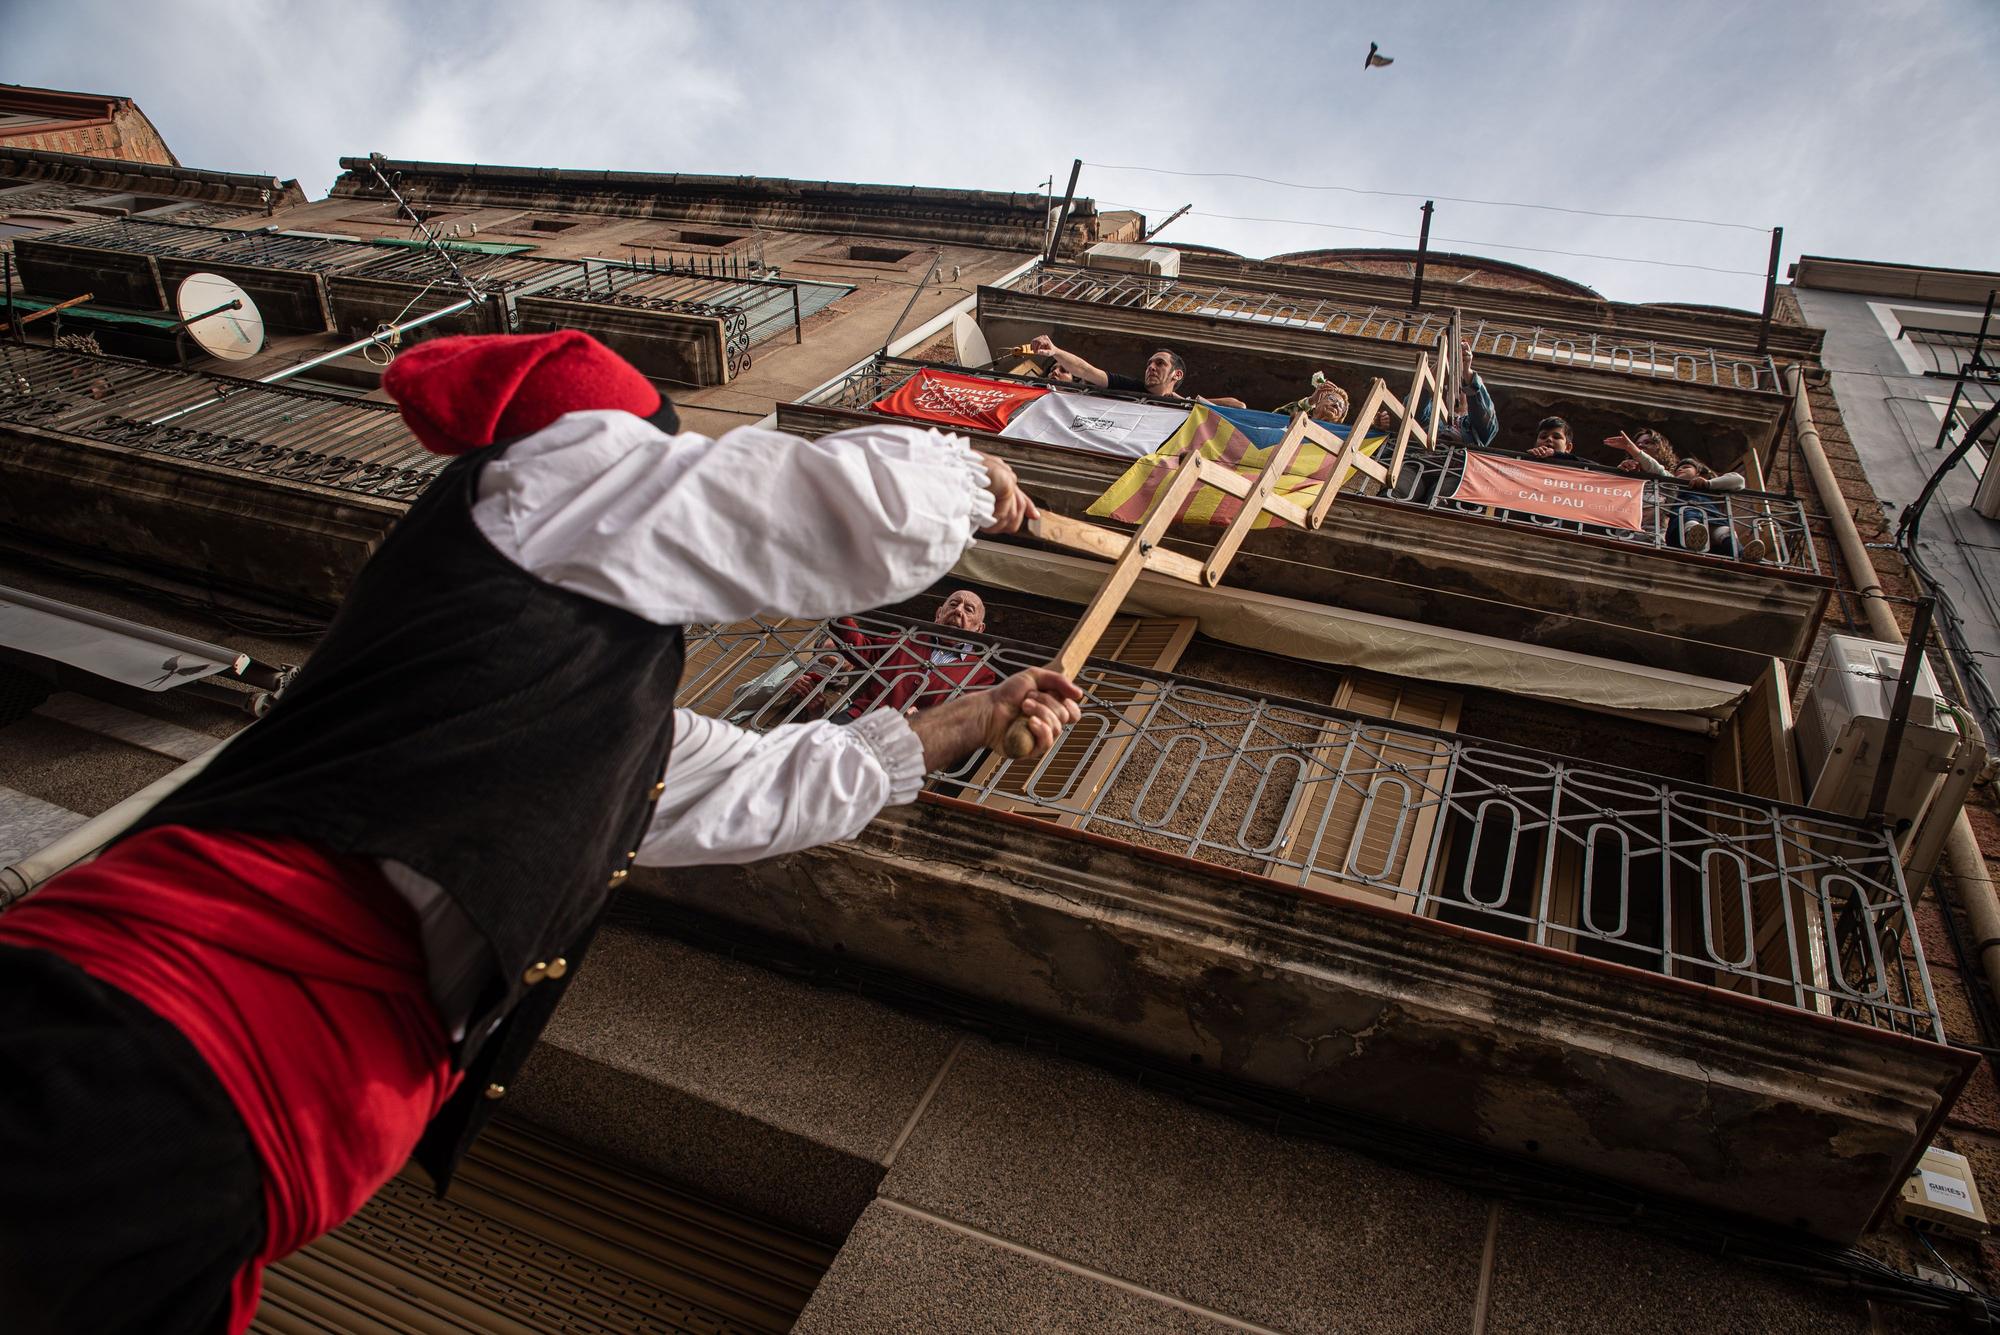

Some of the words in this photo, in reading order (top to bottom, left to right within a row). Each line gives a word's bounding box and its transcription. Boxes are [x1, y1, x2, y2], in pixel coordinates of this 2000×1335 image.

[1543, 478, 1633, 499] BIBLIOTECA
[1517, 490, 1548, 503] CAL
[1552, 495, 1585, 508] PAU
